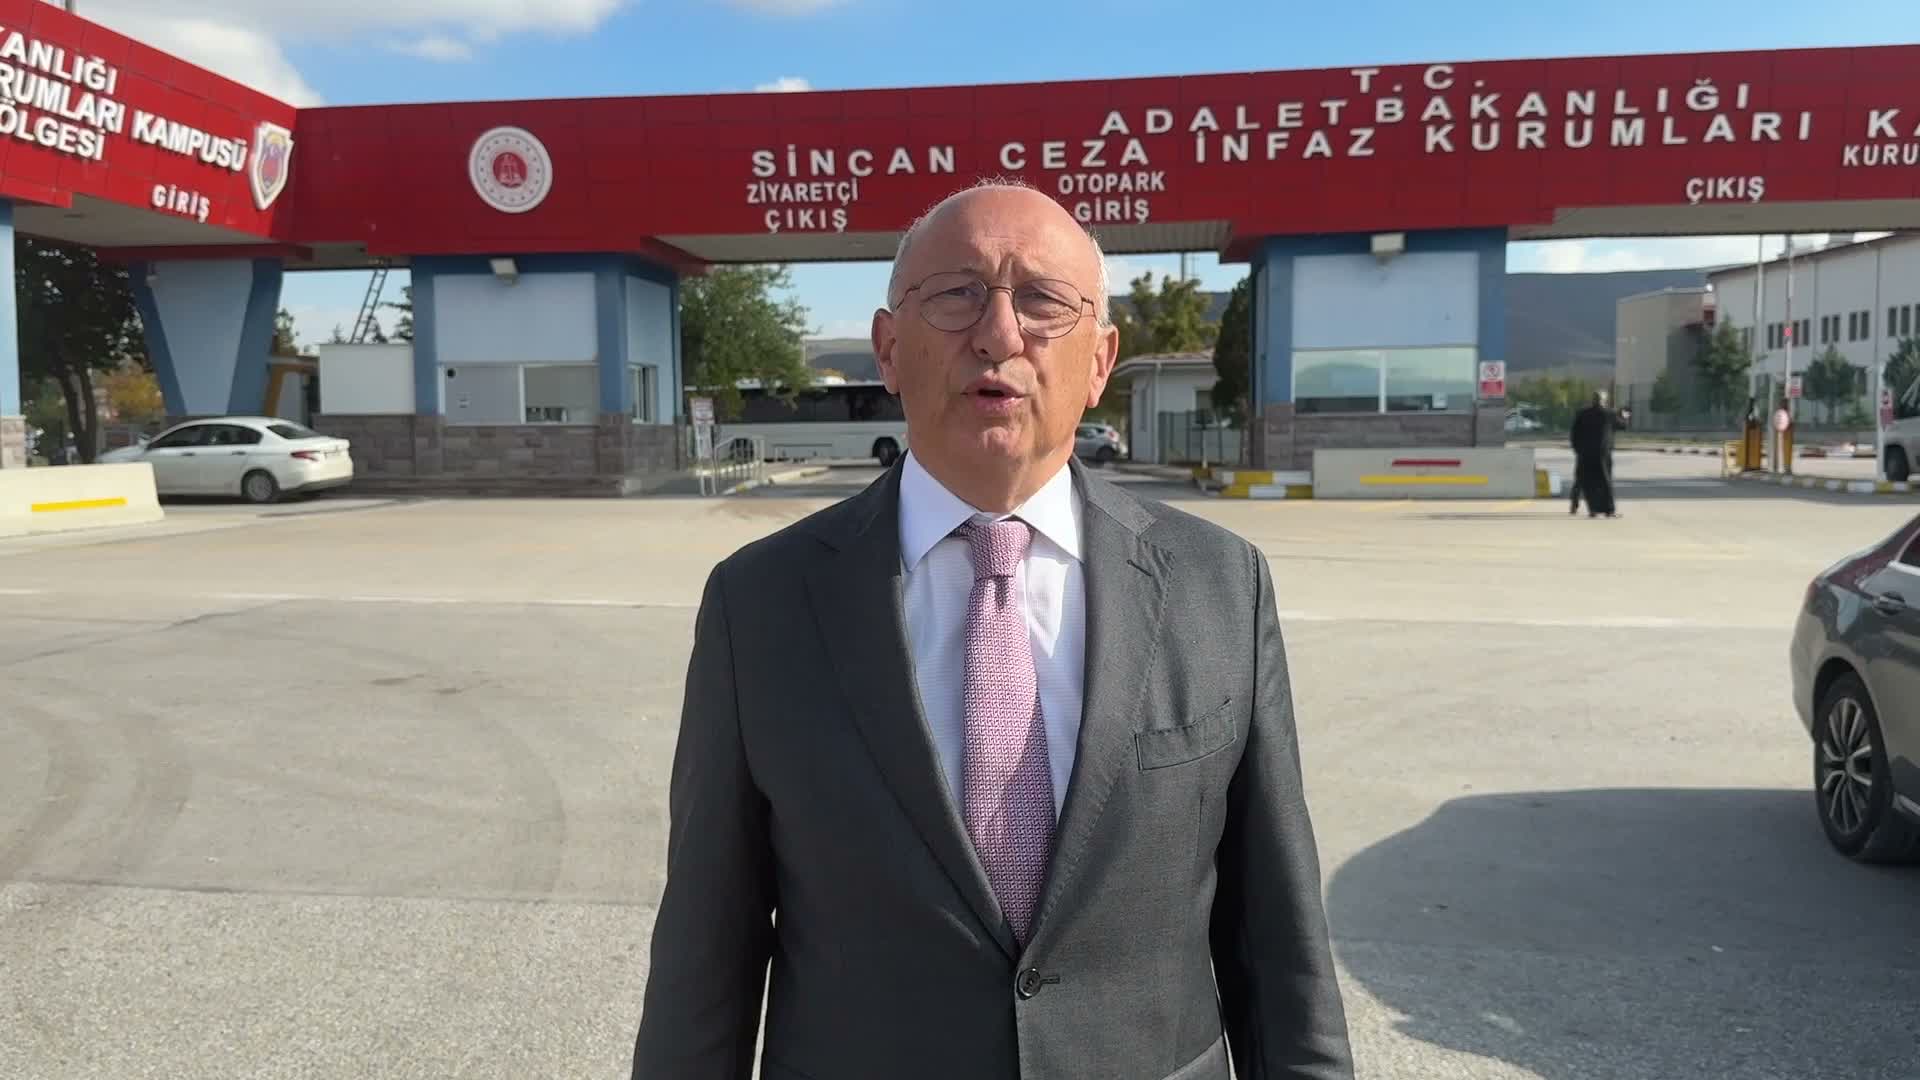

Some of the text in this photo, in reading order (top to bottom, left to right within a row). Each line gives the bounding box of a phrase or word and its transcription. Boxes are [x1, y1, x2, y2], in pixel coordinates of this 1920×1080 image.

[0, 26, 118, 95] ANLIĞI
[1100, 78, 1750, 135] ADALET BAKANLIĞI
[132, 109, 249, 171] KAMPUSÜ
[751, 109, 1920, 178] SİNCAN CEZA İNFAZ KURUMLARI K
[1842, 143, 1920, 167] KURU
[746, 177, 860, 204] ZİYARETÇİ
[1058, 171, 1165, 195] OTOPARK
[1686, 176, 1765, 204] ÇIKIŞ
[152, 184, 211, 223] GİRİŞ
[1074, 197, 1150, 224] GİRİŞ
[764, 206, 849, 233] ÇIKIŞ
